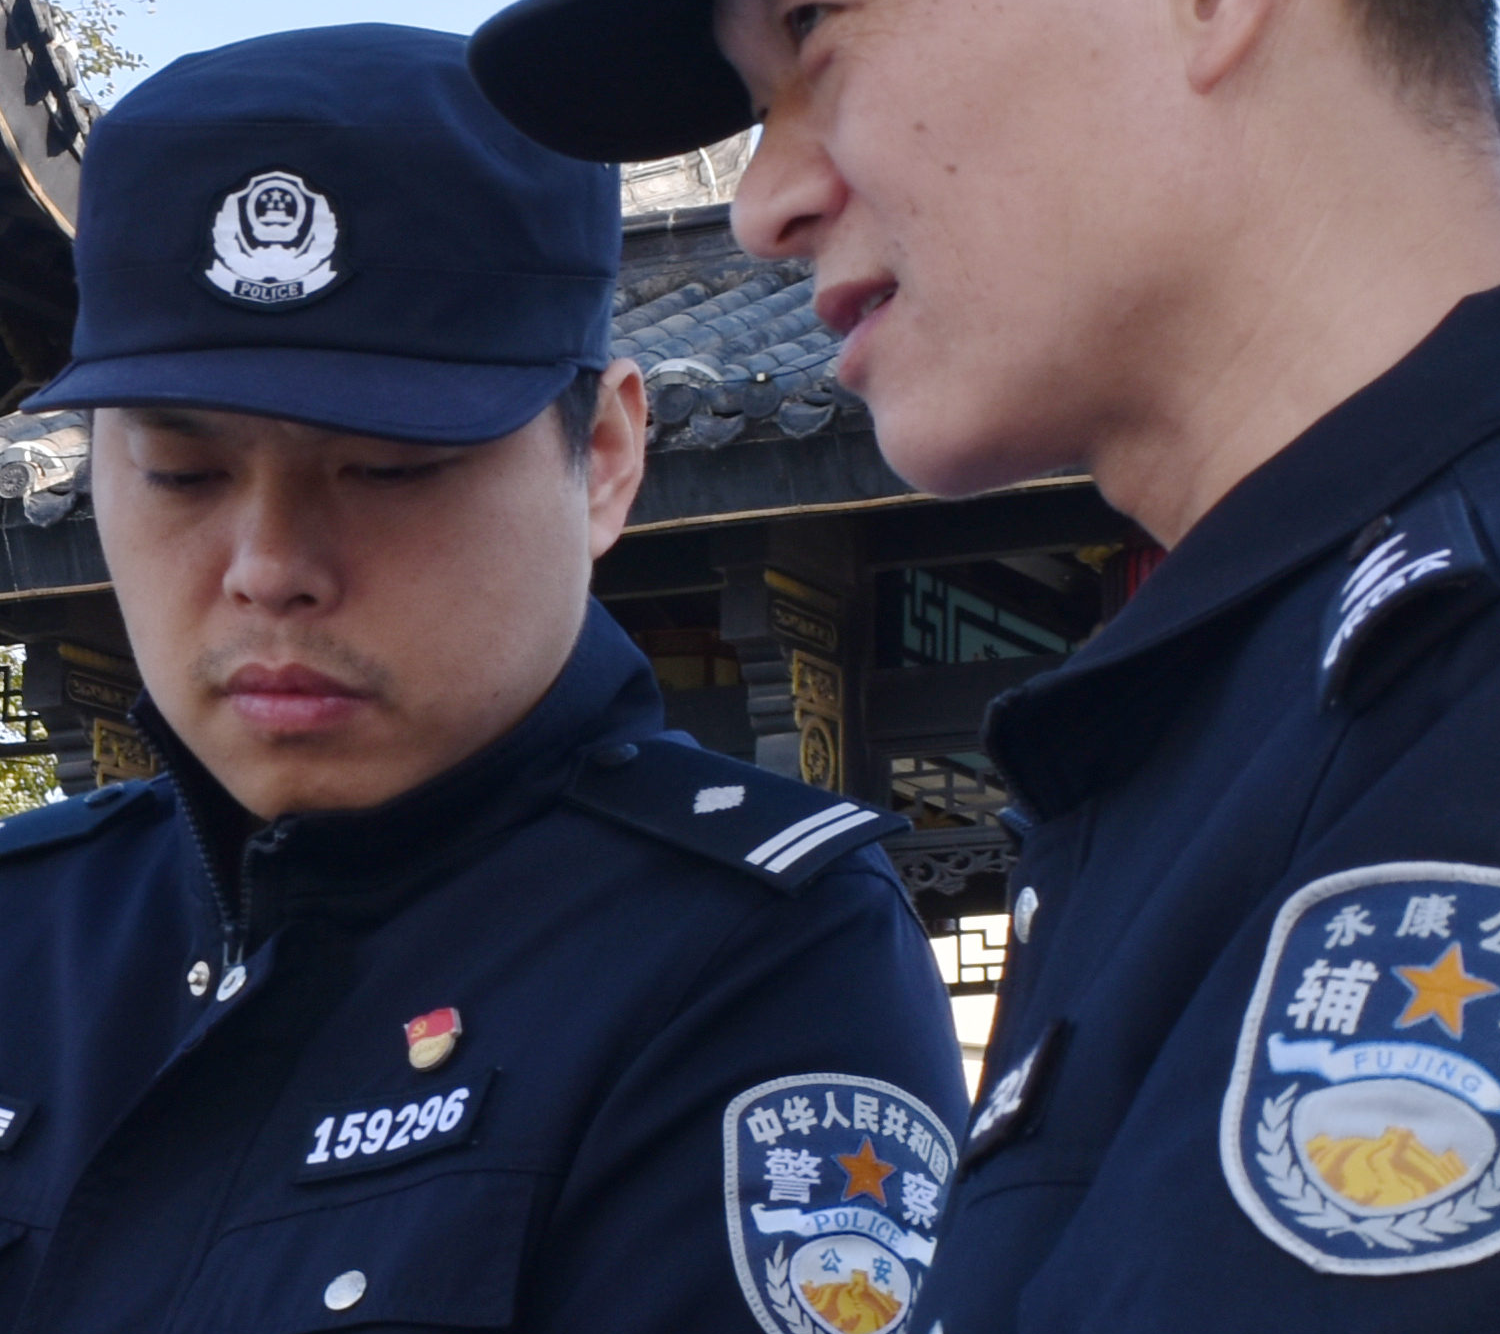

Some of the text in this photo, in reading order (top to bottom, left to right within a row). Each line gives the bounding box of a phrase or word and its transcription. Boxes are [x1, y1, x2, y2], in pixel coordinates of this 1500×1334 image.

[239, 283, 299, 300] POLICE
[306, 1087, 470, 1164] 159296
[747, 1091, 948, 1185] 中华人民共和国
[814, 1213, 901, 1248] POLICE
